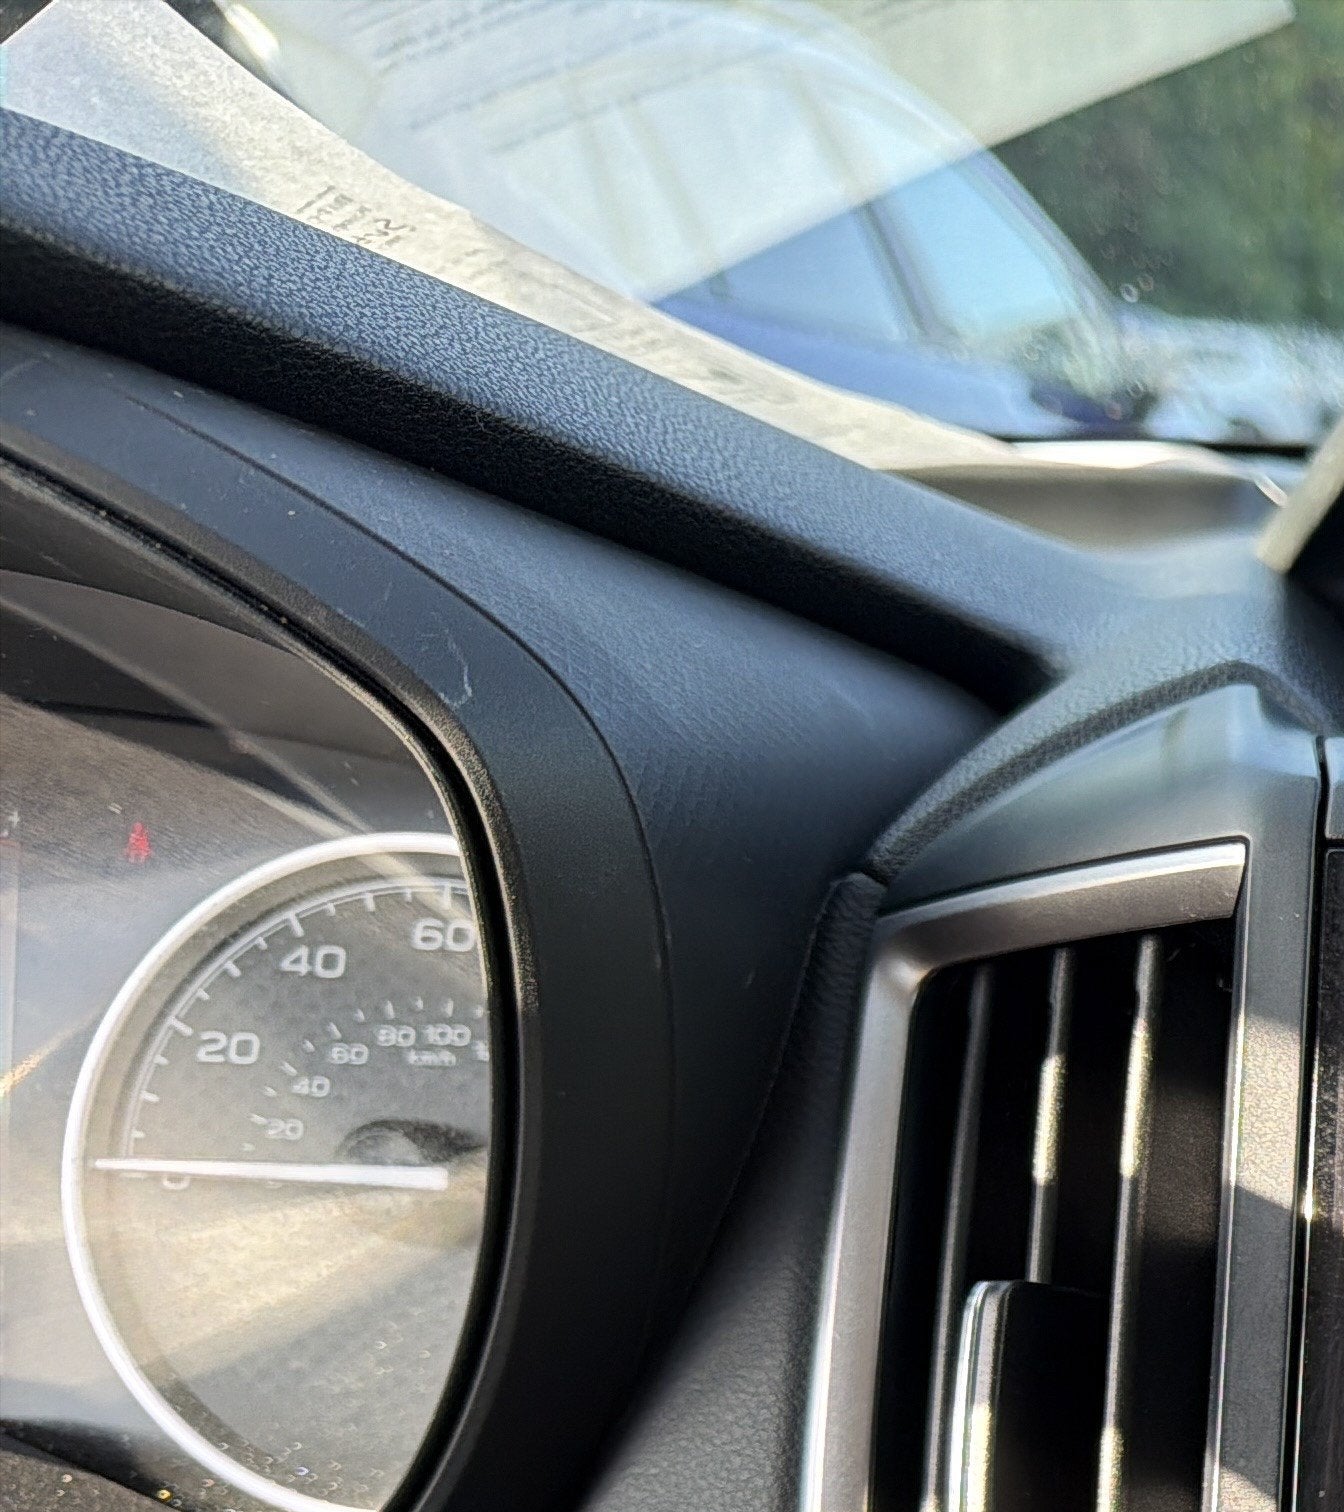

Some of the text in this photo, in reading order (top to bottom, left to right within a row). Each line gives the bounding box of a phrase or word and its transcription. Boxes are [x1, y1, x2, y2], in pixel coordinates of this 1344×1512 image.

[412, 918, 477, 952] 60
[279, 945, 347, 978] 40
[197, 1030, 260, 1065] 20
[265, 1118, 304, 1141] 20
